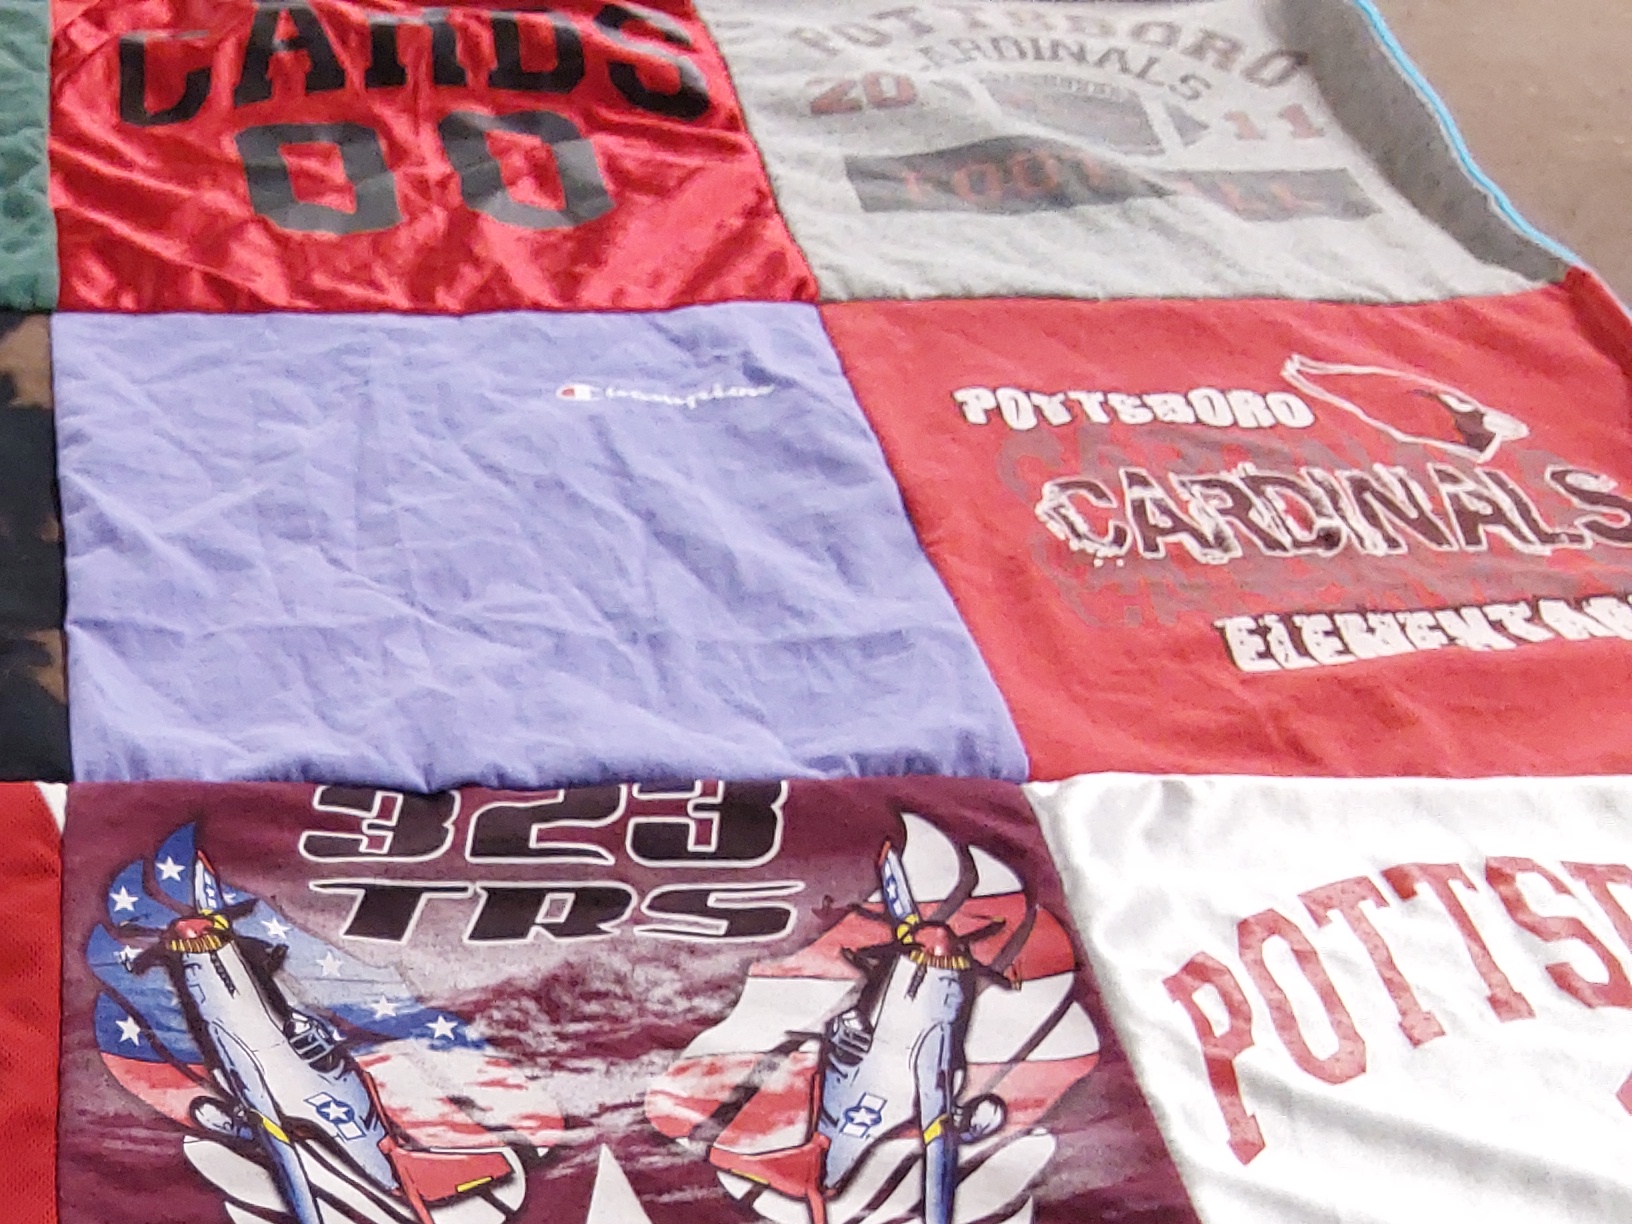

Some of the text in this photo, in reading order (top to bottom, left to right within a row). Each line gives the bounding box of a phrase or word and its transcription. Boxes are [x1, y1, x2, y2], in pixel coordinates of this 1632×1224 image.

[1223, 103, 1325, 140] 11
[953, 386, 1316, 430] POTTSBORO
[1034, 461, 1632, 566] CARDINALS
[1213, 595, 1632, 673] ELEMENTAR
[298, 779, 790, 868] 323
[306, 877, 806, 944] TRS
